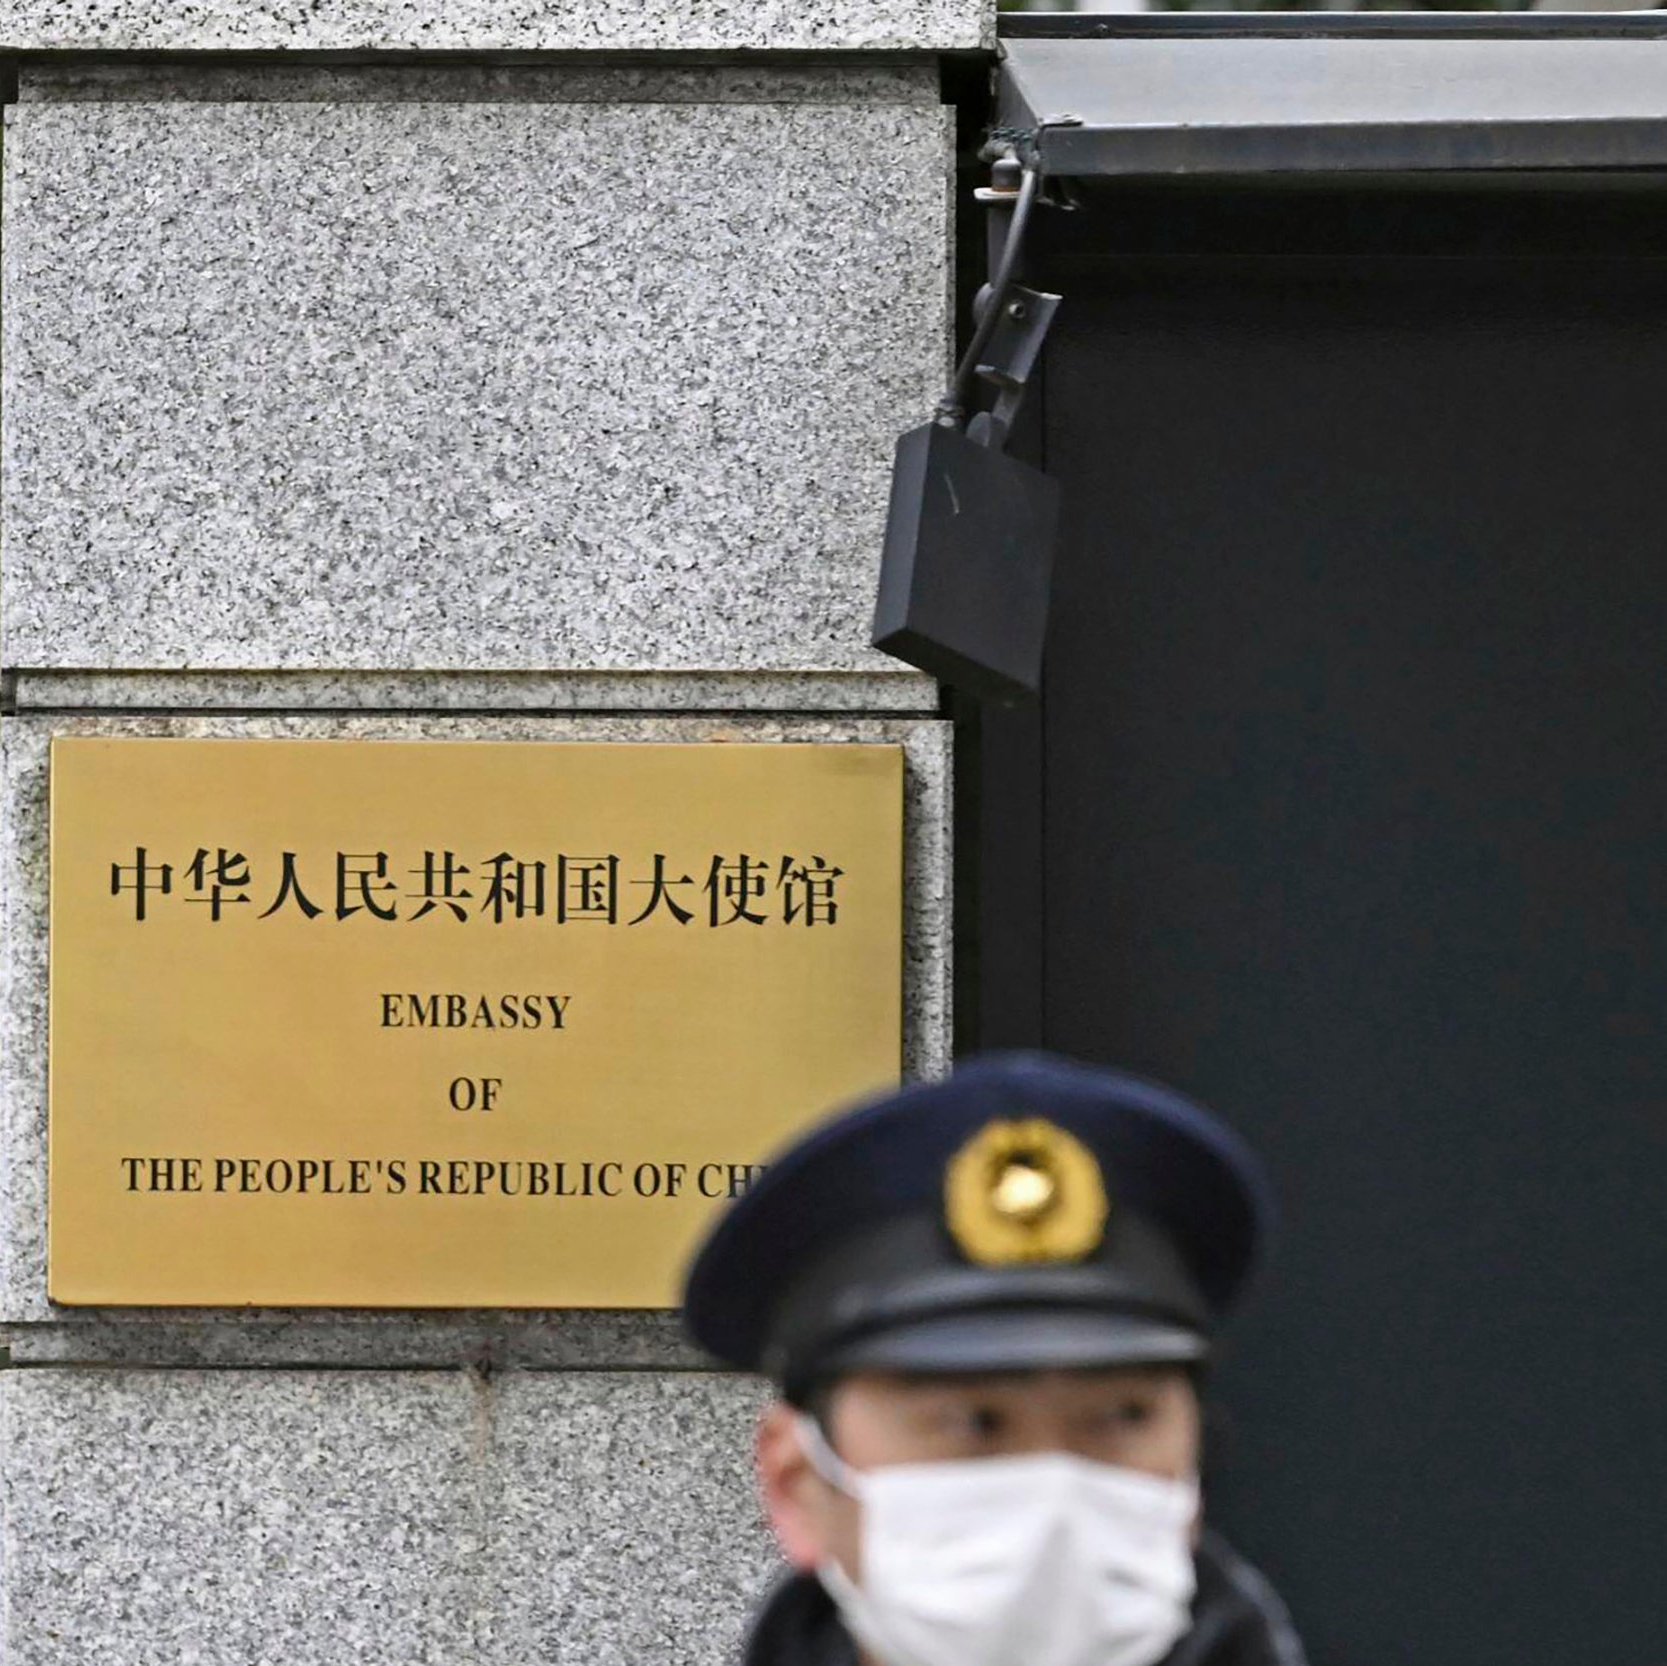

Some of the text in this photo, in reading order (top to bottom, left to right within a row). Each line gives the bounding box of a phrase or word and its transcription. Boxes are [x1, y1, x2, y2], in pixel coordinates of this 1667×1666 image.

[108, 845, 845, 928] 中华人民共和国大使馆
[380, 993, 572, 1030] EMBASSY
[448, 1076, 503, 1112] OF
[120, 1157, 203, 1192] THE
[213, 1158, 408, 1195] PEOPLE'S
[418, 1160, 623, 1197] REPUBLIC
[633, 1162, 687, 1197] OF
